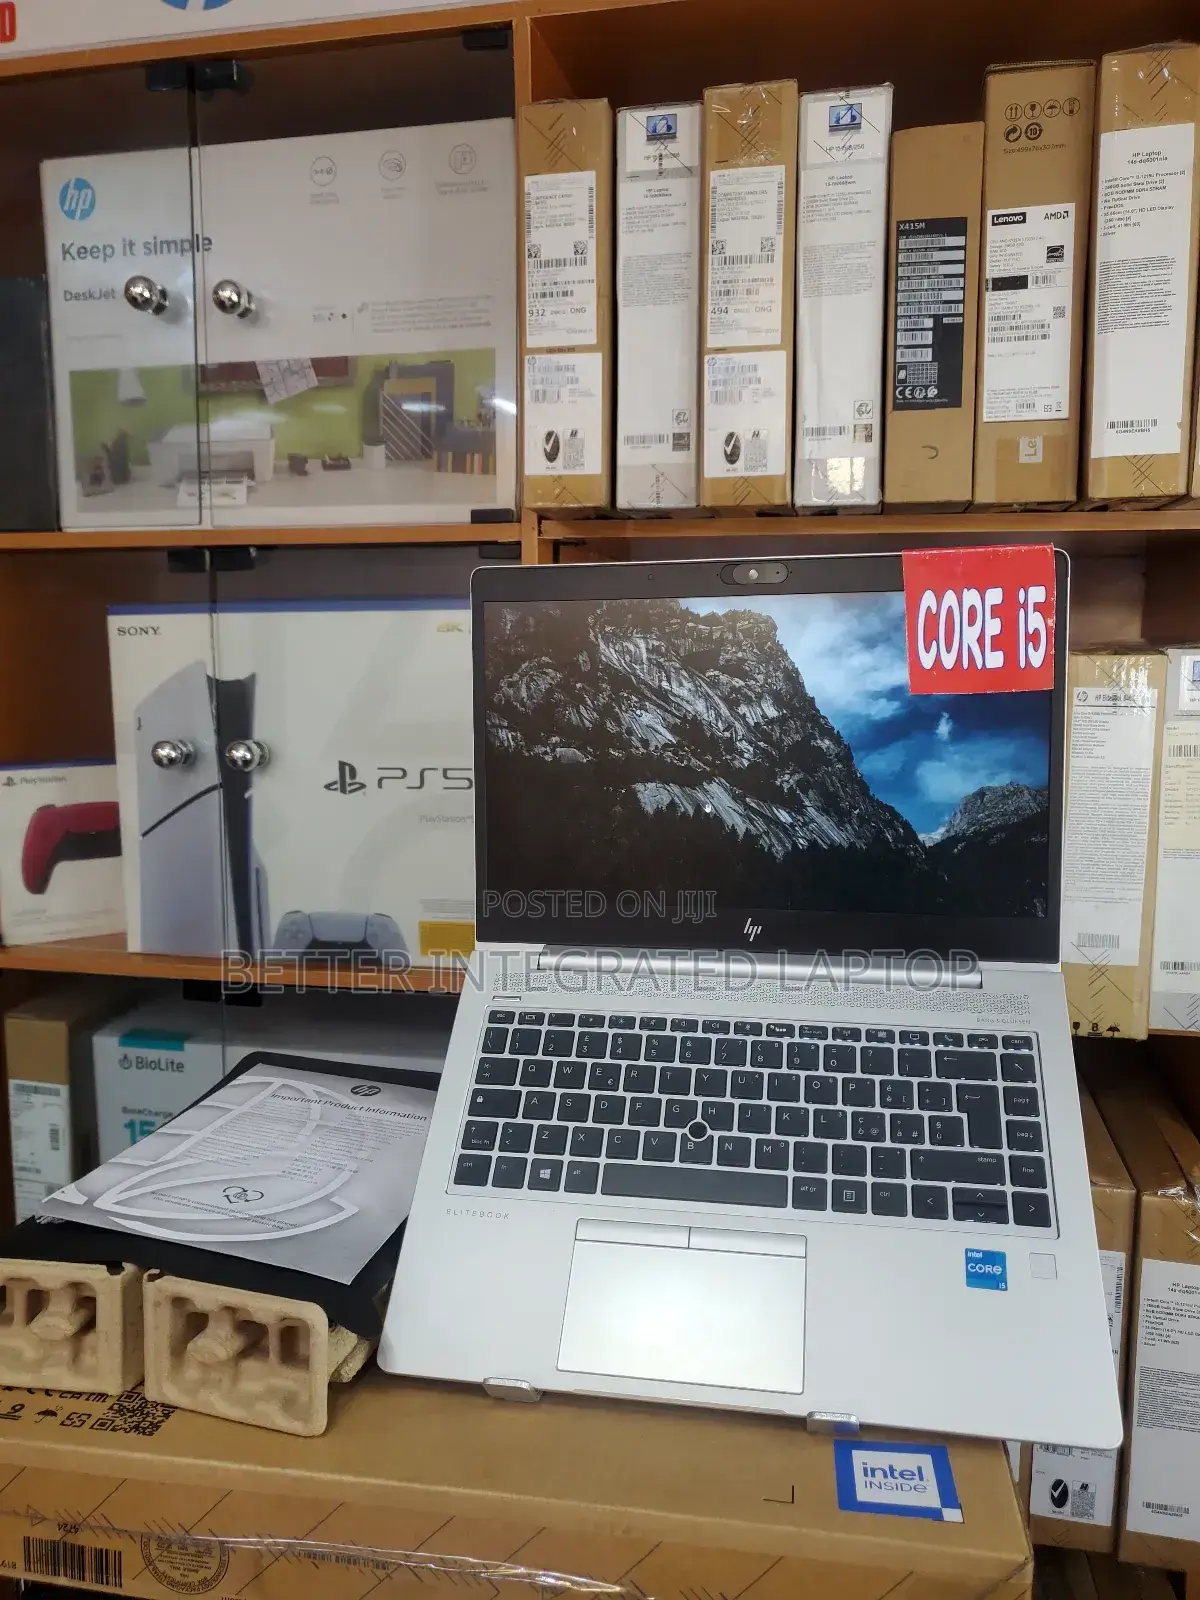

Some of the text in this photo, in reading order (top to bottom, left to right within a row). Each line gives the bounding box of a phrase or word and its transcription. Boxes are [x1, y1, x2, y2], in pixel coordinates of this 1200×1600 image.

[1142, 150, 1161, 158] Laptop
[60, 177, 96, 221] hp
[994, 211, 1062, 224] Lenovo AMD
[899, 221, 925, 230] X415M
[61, 233, 213, 263] Keep it simple
[63, 288, 116, 301] DeskJet
[528, 309, 546, 317] 932
[711, 305, 772, 315] 494 ONG
[117, 626, 161, 636] SONY
[917, 585, 1047, 670] CORE i5
[20, 775, 68, 785] PlayStation
[377, 767, 474, 790] PS5
[743, 918, 762, 942] hp
[134, 1056, 185, 1073] BioLite
[528, 1064, 536, 1072] Q
[562, 1066, 573, 1074] W
[595, 1068, 603, 1076] E
[630, 1070, 638, 1078] R
[666, 1071, 672, 1079] T
[702, 1074, 709, 1082] Y
[738, 1076, 746, 1084] U
[812, 1081, 820, 1089] O
[849, 1083, 856, 1091] P
[531, 1097, 539, 1105] A
[565, 1099, 572, 1107] S
[600, 1101, 608, 1109] D
[270, 1093, 428, 1122] Important Product Information
[672, 1105, 680, 1113] G
[708, 1107, 716, 1115] H
[121, 1106, 174, 1118] BaseCharge
[745, 1110, 751, 1118] J
[820, 1115, 827, 1123] L
[541, 1130, 550, 1139] Z
[870, 1127, 879, 1135] @
[911, 1130, 918, 1138] #
[578, 1133, 585, 1141] X
[614, 1136, 622, 1144] C
[651, 1137, 659, 1145] V
[687, 1142, 695, 1150] B
[724, 1142, 733, 1151] N
[763, 1145, 772, 1153] M
[977, 1156, 997, 1164] stamp
[1022, 1166, 1035, 1174] fine
[446, 1208, 510, 1220] ELITEBOOK
[862, 1462, 925, 1482] intel
